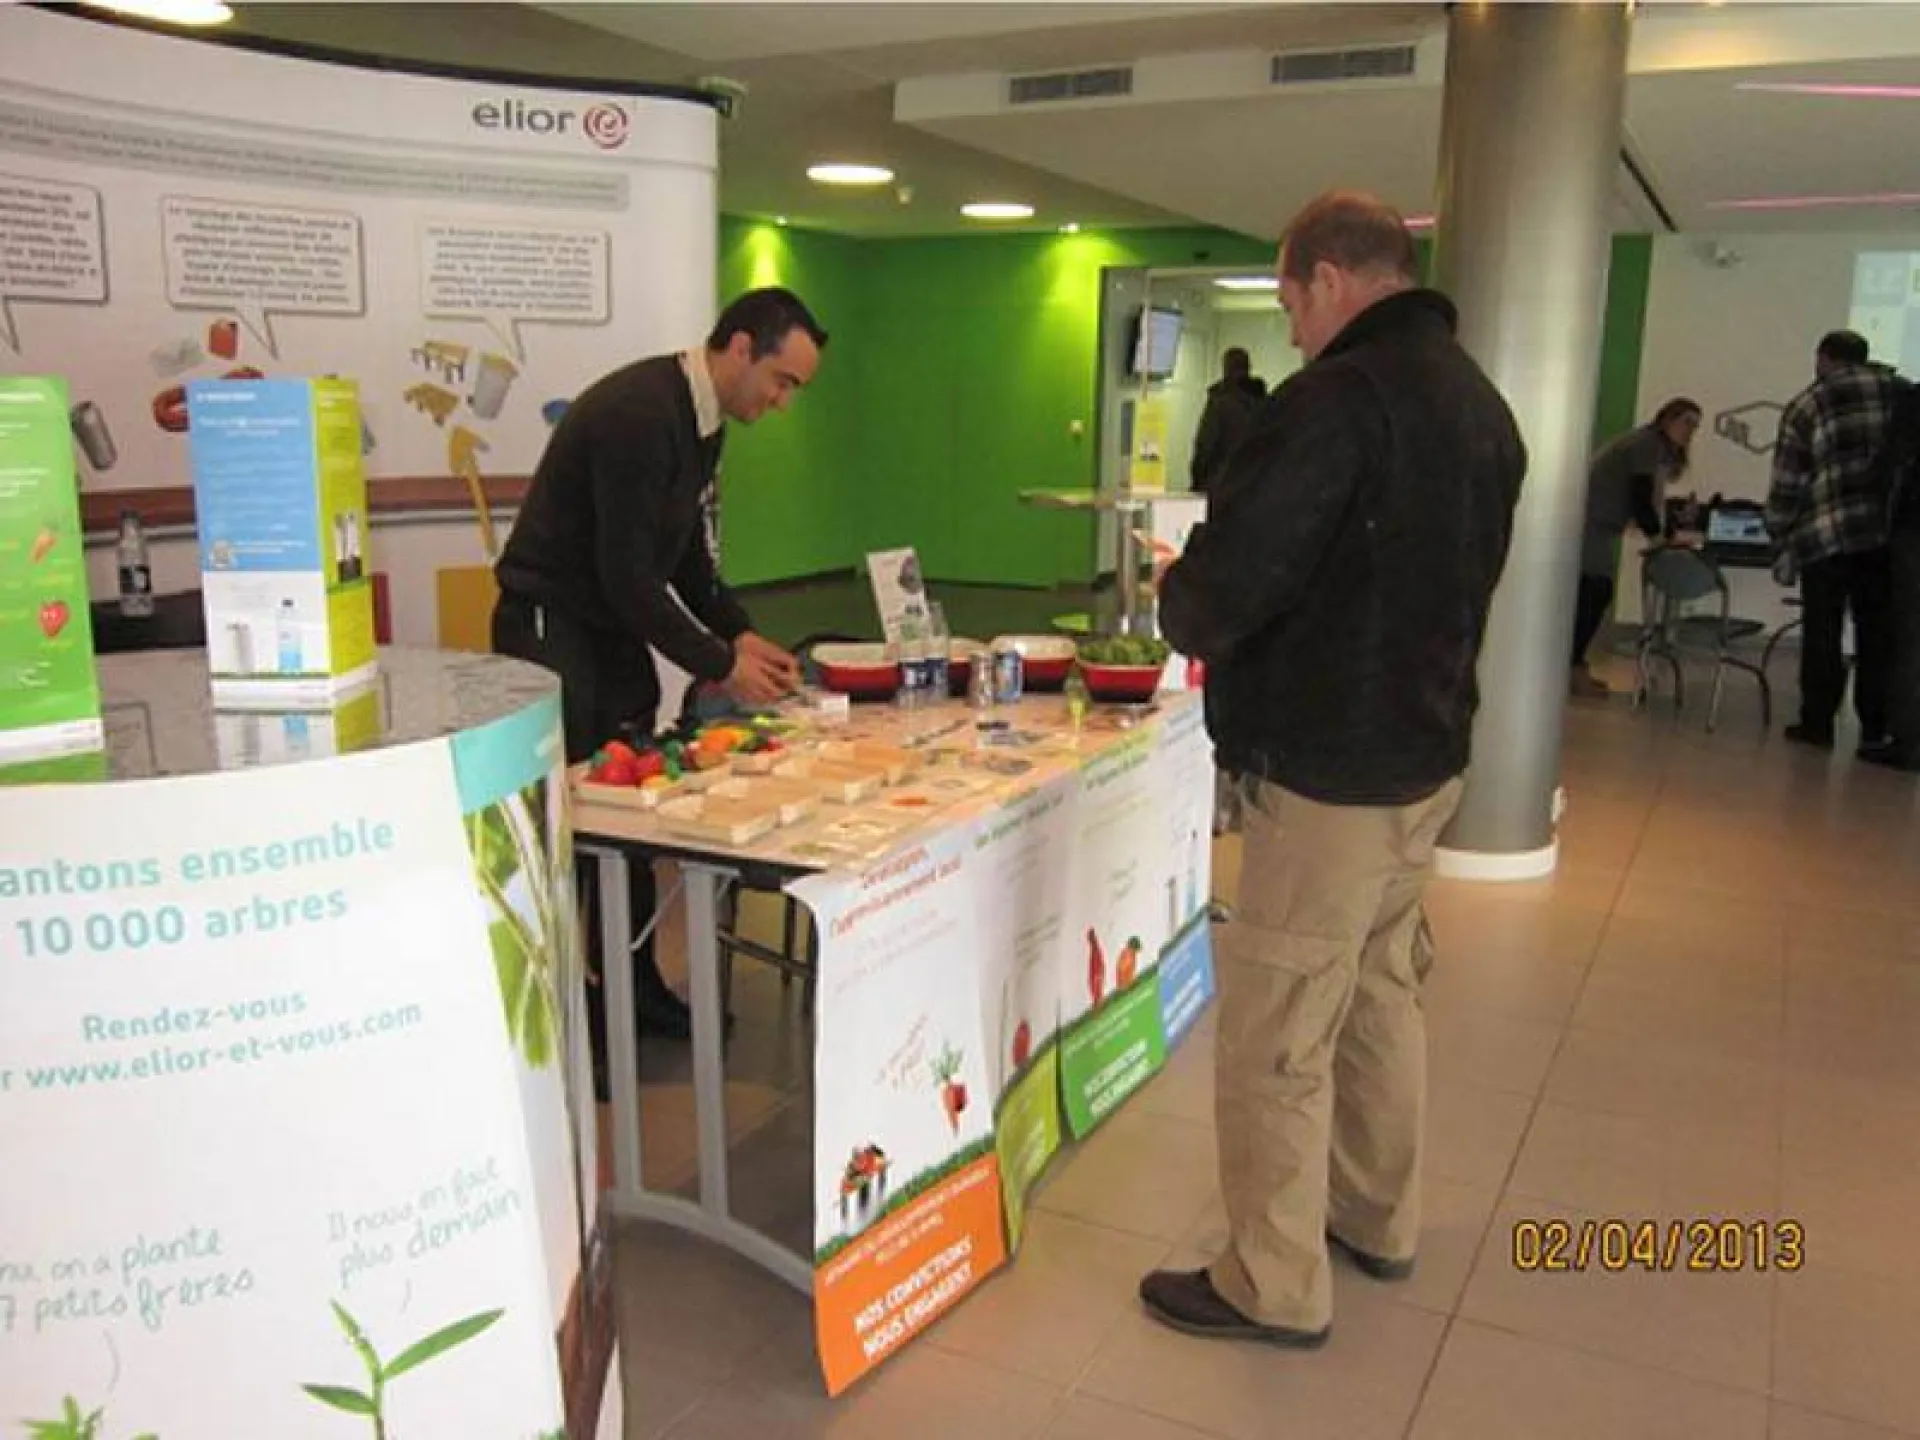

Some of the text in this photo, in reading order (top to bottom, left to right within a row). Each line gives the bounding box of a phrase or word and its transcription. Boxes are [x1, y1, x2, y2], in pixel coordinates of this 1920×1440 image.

[472, 100, 575, 134] elior
[179, 818, 395, 883] ensemble
[16, 888, 349, 957] 10 000 arbres
[25, 1001, 422, 1089] www.elior-et-vous.com
[81, 991, 308, 1043] Rendez-vous
[339, 1189, 521, 1290] plus demain
